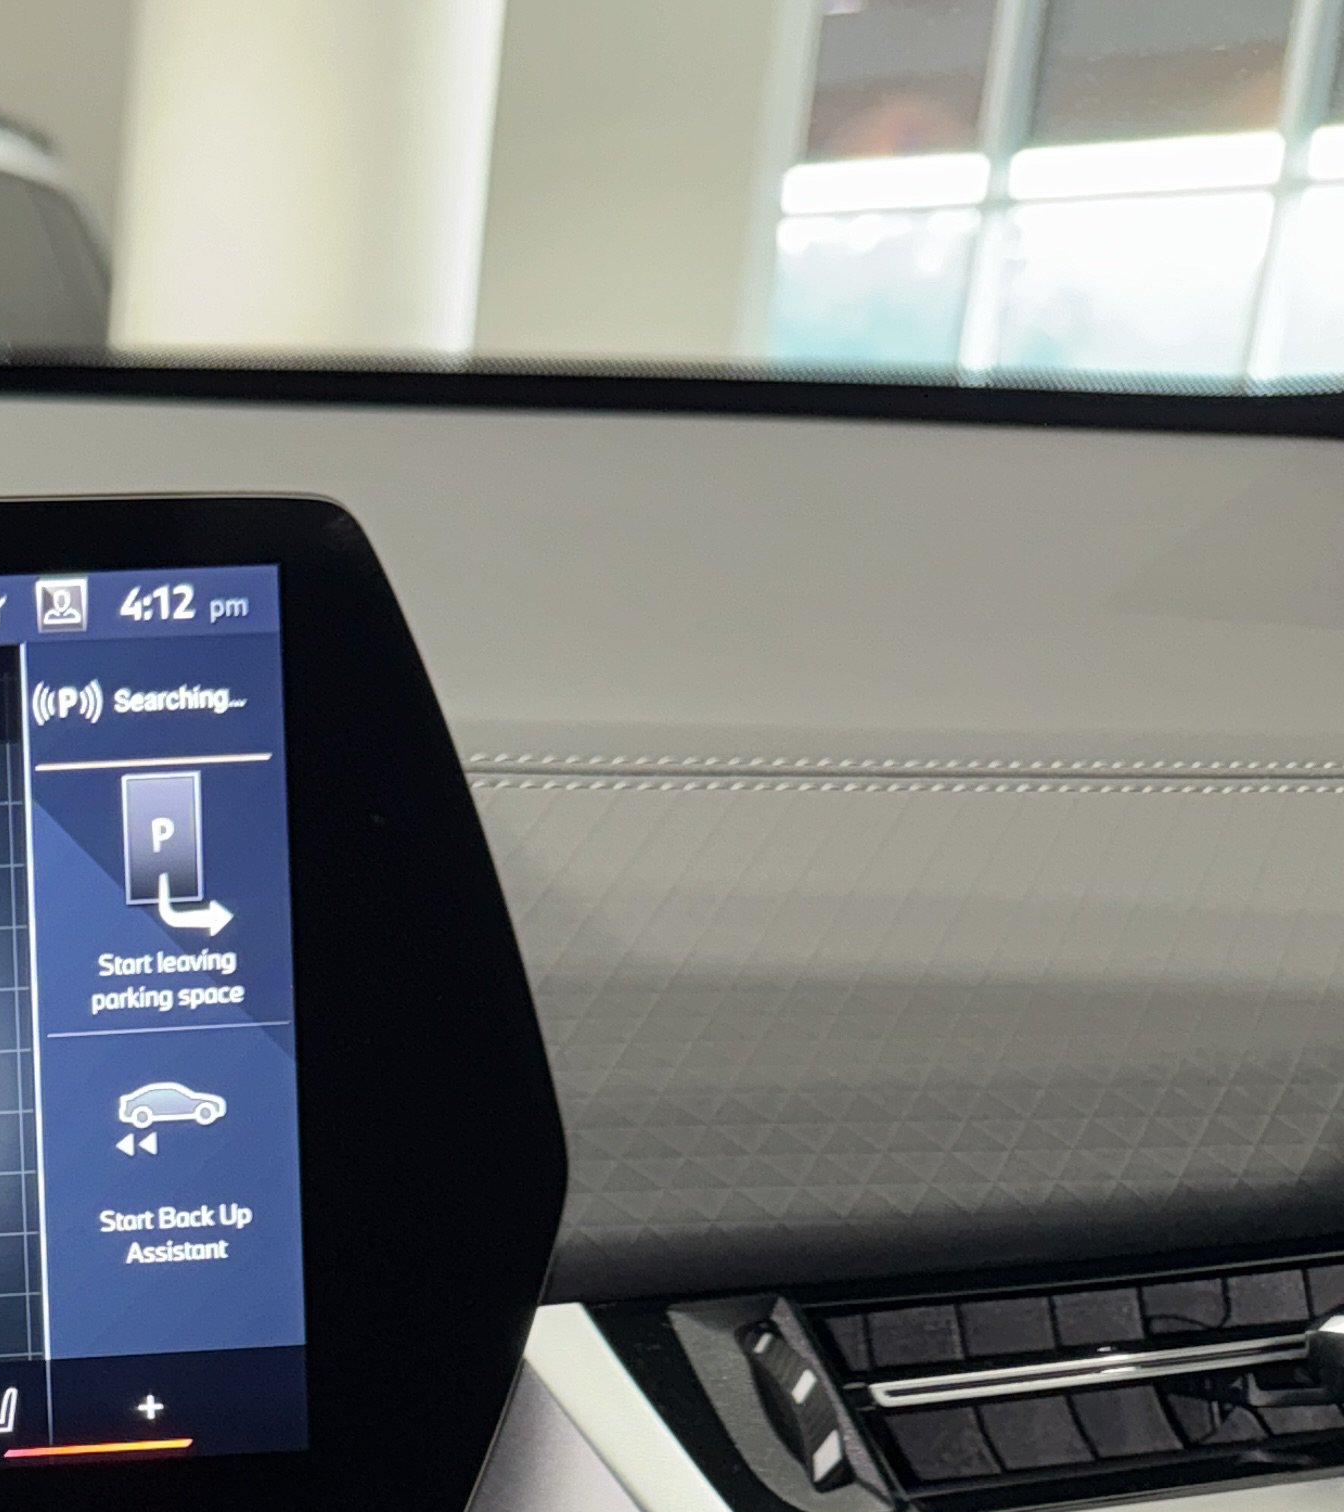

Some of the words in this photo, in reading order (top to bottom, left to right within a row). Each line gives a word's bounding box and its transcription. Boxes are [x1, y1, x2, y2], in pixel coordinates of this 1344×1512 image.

[120, 584, 195, 620] 4:12
[210, 597, 249, 622] pm
[114, 684, 247, 713] Searching...
[98, 954, 152, 976] Start
[157, 949, 236, 974] leaving
[92, 986, 173, 1014] parking
[178, 985, 245, 1008] space
[99, 1209, 154, 1232] Start
[159, 1205, 215, 1229] Back
[220, 1203, 252, 1229] Up
[126, 1240, 229, 1264] Assistant
